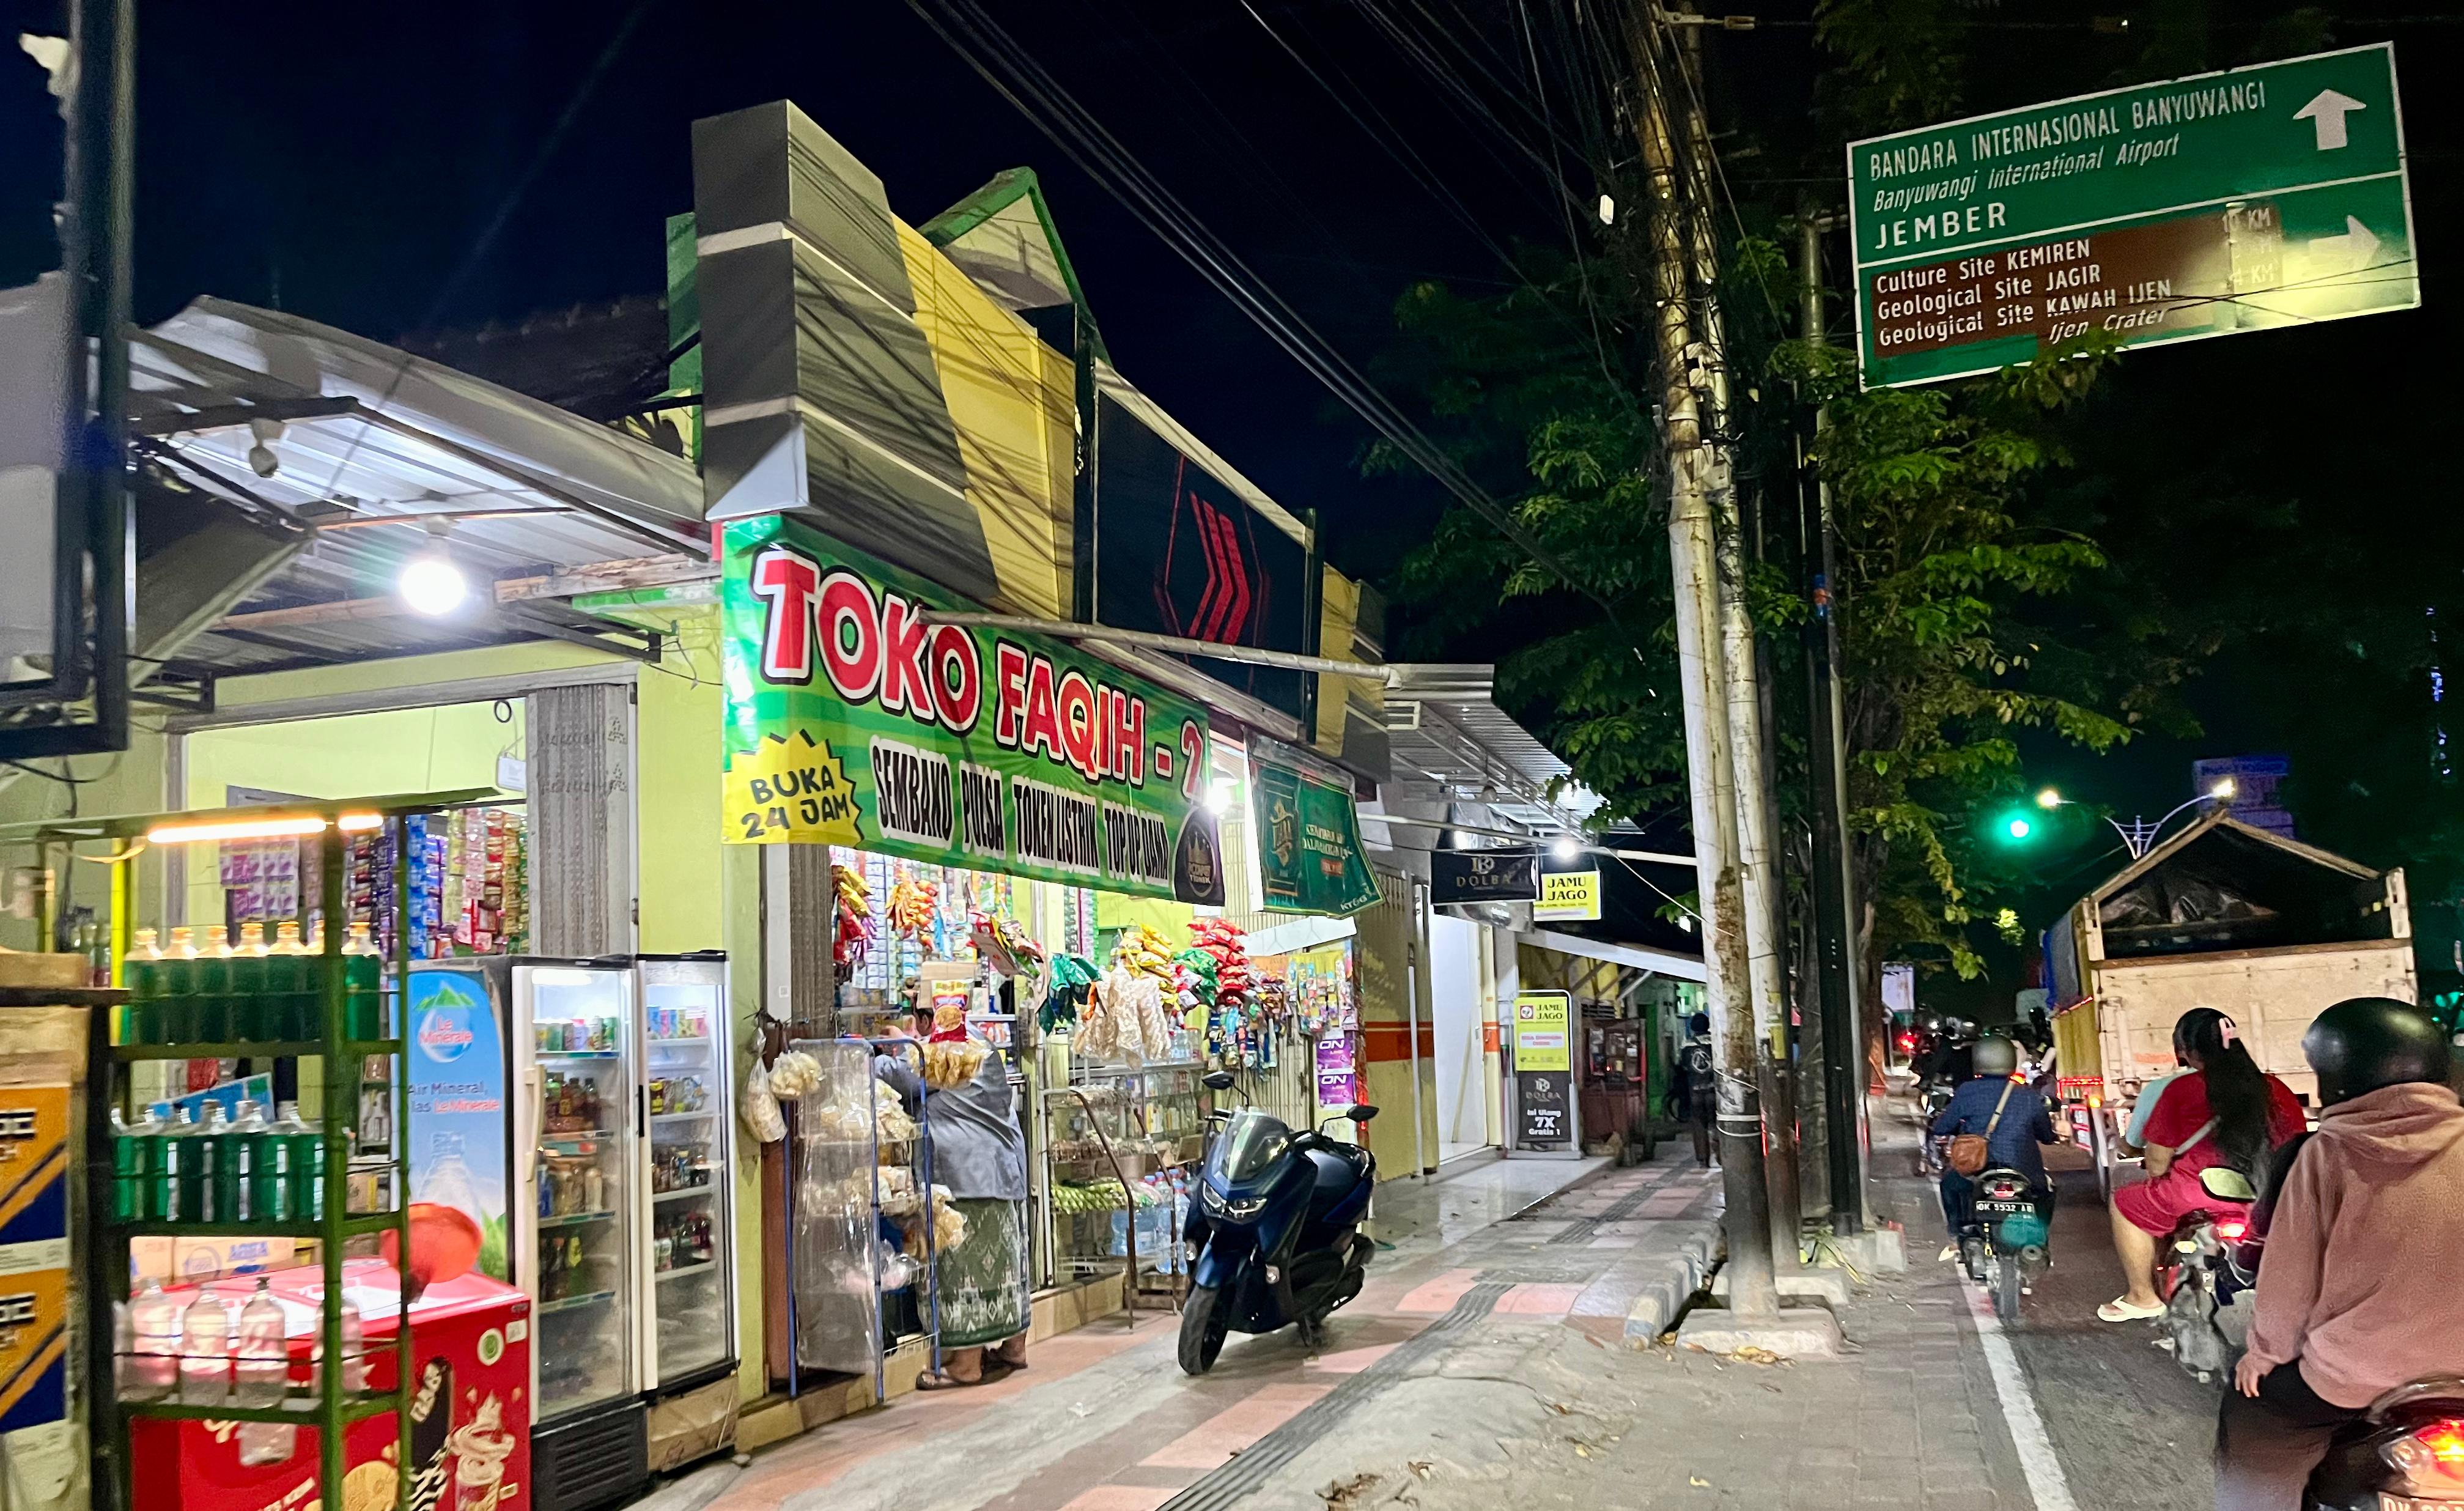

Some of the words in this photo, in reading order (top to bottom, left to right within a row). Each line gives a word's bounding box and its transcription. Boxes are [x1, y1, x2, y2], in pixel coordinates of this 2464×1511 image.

[1871, 139, 1957, 181] BANDARA
[1972, 106, 2120, 161] INTERNASIONAL
[2132, 80, 2265, 130] BANYUWANGI
[1873, 170, 1978, 212] Banyuwangi
[1988, 146, 2104, 190] International
[2116, 133, 2180, 166] Airport
[1875, 202, 2006, 249] JEMBER
[1876, 268, 1947, 294] Culture
[1959, 258, 1995, 280] Site
[2007, 238, 2090, 271] KEMIREN
[1878, 284, 1982, 320] Geological
[1995, 277, 2032, 300] Site
[2046, 264, 2101, 292] JAGIR
[1879, 311, 1983, 346] Geological
[1996, 304, 2034, 327] Site
[2046, 289, 2116, 317] KAWAH
[2128, 279, 2172, 304] IJEN
[2049, 320, 2089, 345] Ijen
[2103, 308, 2168, 336] Crater
[753, 549, 980, 733] TOKO
[995, 641, 1145, 785] FAQIH
[1181, 720, 1203, 800] 2
[750, 764, 835, 804] BUKA
[741, 807, 791, 839] 24
[800, 793, 850, 825] JAM
[872, 745, 953, 842] SEMBAKO
[961, 767, 1005, 851] PULSA
[1014, 783, 1055, 861] TOKEN
[1056, 792, 1099, 869] LISTRIK
[1104, 807, 1126, 873] TOP
[1127, 812, 1141, 876] UP
[1142, 815, 1168, 881] DANA
[1547, 876, 1587, 888] JAMU
[1547, 890, 1587, 901] JAGO
[437, 1017, 453, 1031] Le
[1319, 1040, 1345, 1049] ON
[1321, 1074, 1347, 1085] ON
[1535, 1116, 1555, 1128] 7X
